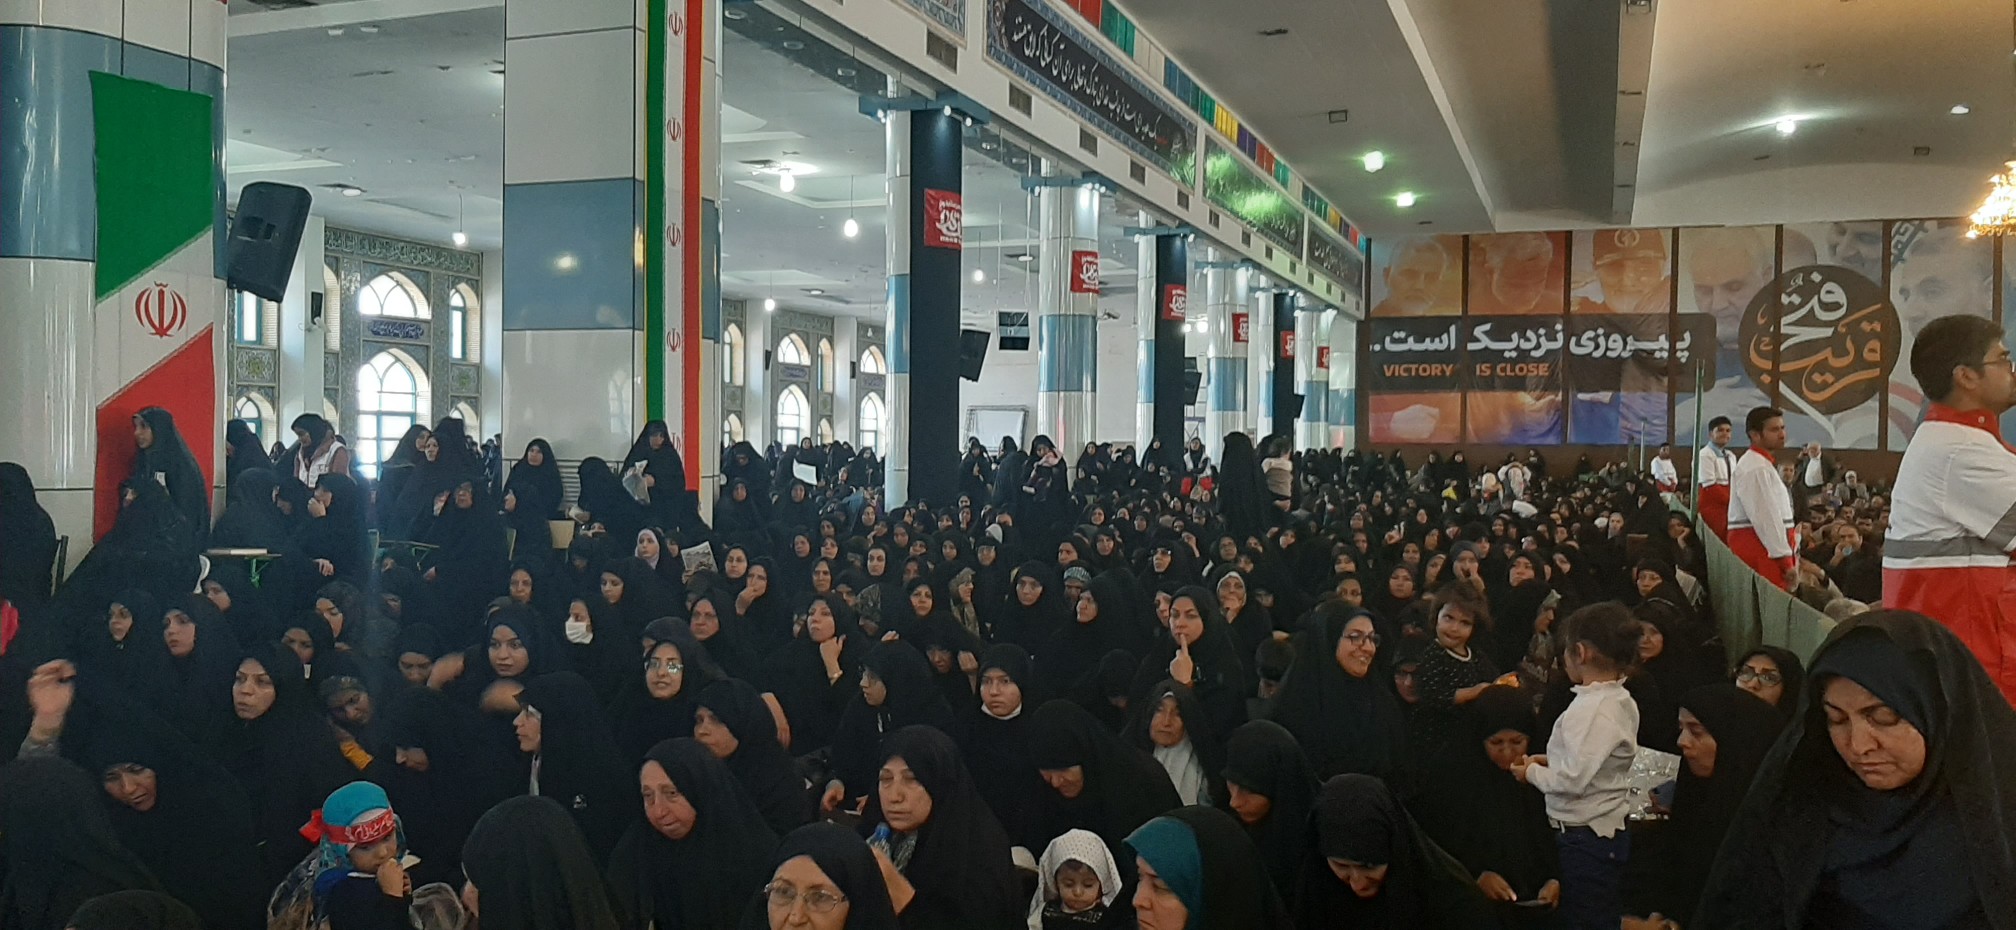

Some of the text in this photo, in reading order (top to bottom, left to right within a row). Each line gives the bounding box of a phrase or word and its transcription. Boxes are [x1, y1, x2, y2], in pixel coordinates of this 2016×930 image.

[1467, 322, 1564, 358] نزدیک
[1569, 327, 1691, 363] پیروزی
[1383, 363, 1551, 377] VICTORY IS CLOSE
